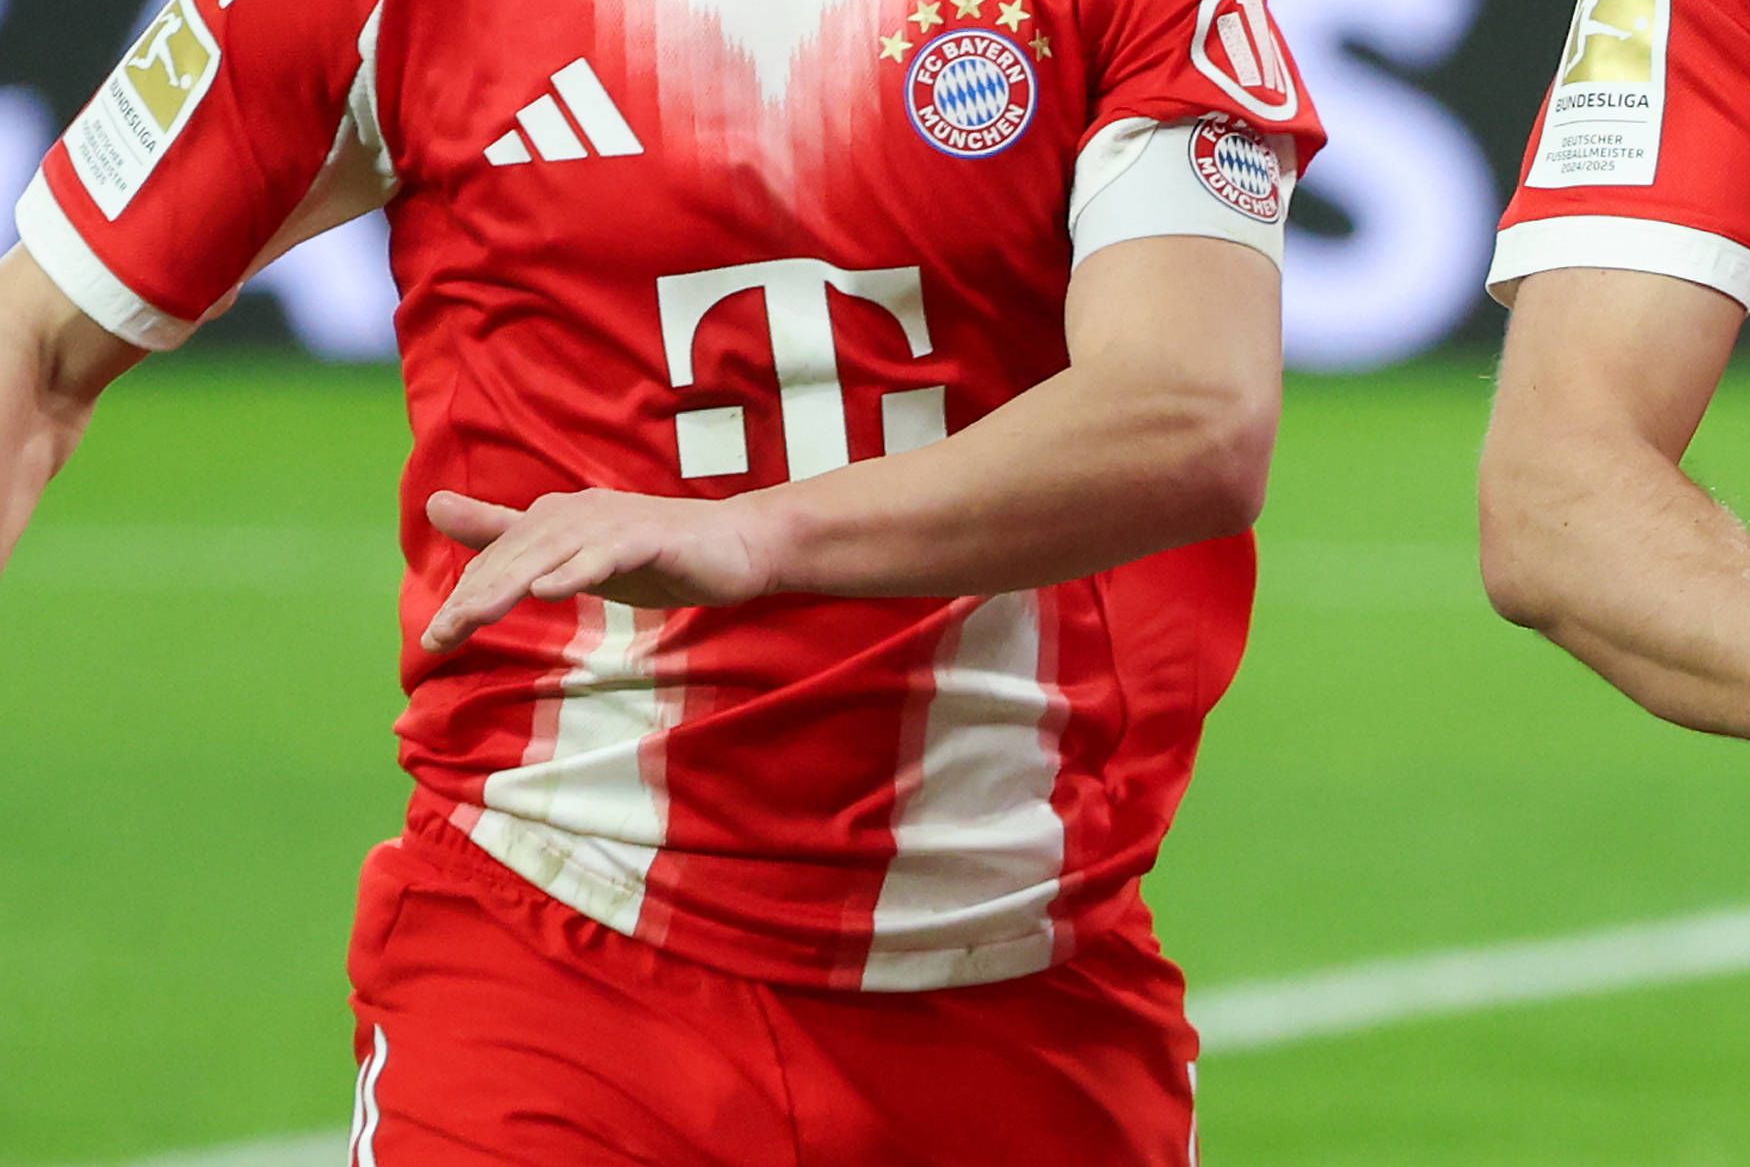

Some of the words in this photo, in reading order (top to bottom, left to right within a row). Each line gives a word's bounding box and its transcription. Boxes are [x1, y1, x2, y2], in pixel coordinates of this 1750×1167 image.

[916, 55, 943, 85] FC
[941, 37, 1026, 84] BAYERN
[1556, 93, 1649, 112] BUNDESLIGA
[110, 77, 157, 154] BUNDESLIGA
[918, 103, 1025, 150] MÜNCHEN
[1562, 134, 1623, 148] DEUTSCHER
[1546, 147, 1644, 162] FUSSBALLMEISTER
[1561, 160, 1615, 173] 2024/2025
